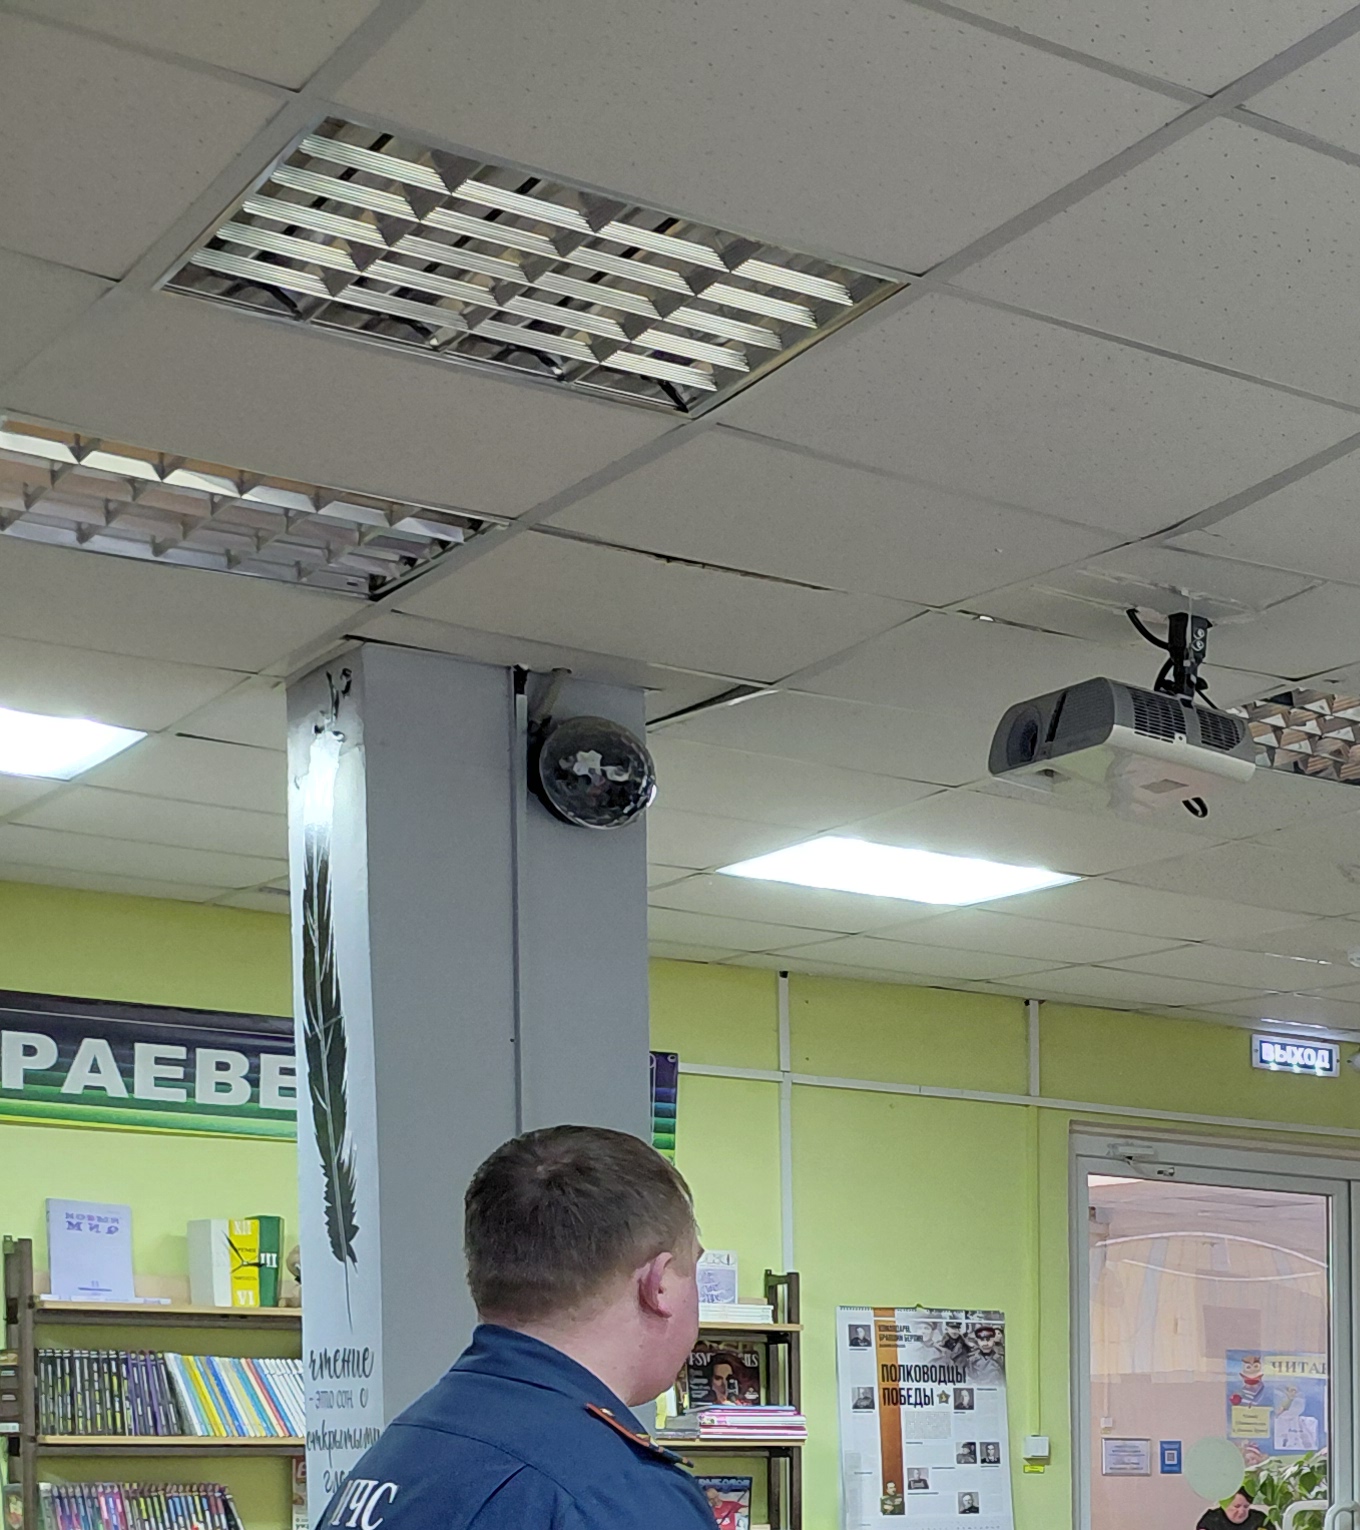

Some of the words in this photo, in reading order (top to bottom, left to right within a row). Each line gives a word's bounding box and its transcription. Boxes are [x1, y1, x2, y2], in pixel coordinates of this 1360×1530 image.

[1261, 1042, 1330, 1068] ВЫХОД
[881, 1363, 967, 1386] ПОЛКОВОДЦЫ
[882, 1387, 935, 1409] ПОБЕДЫ
